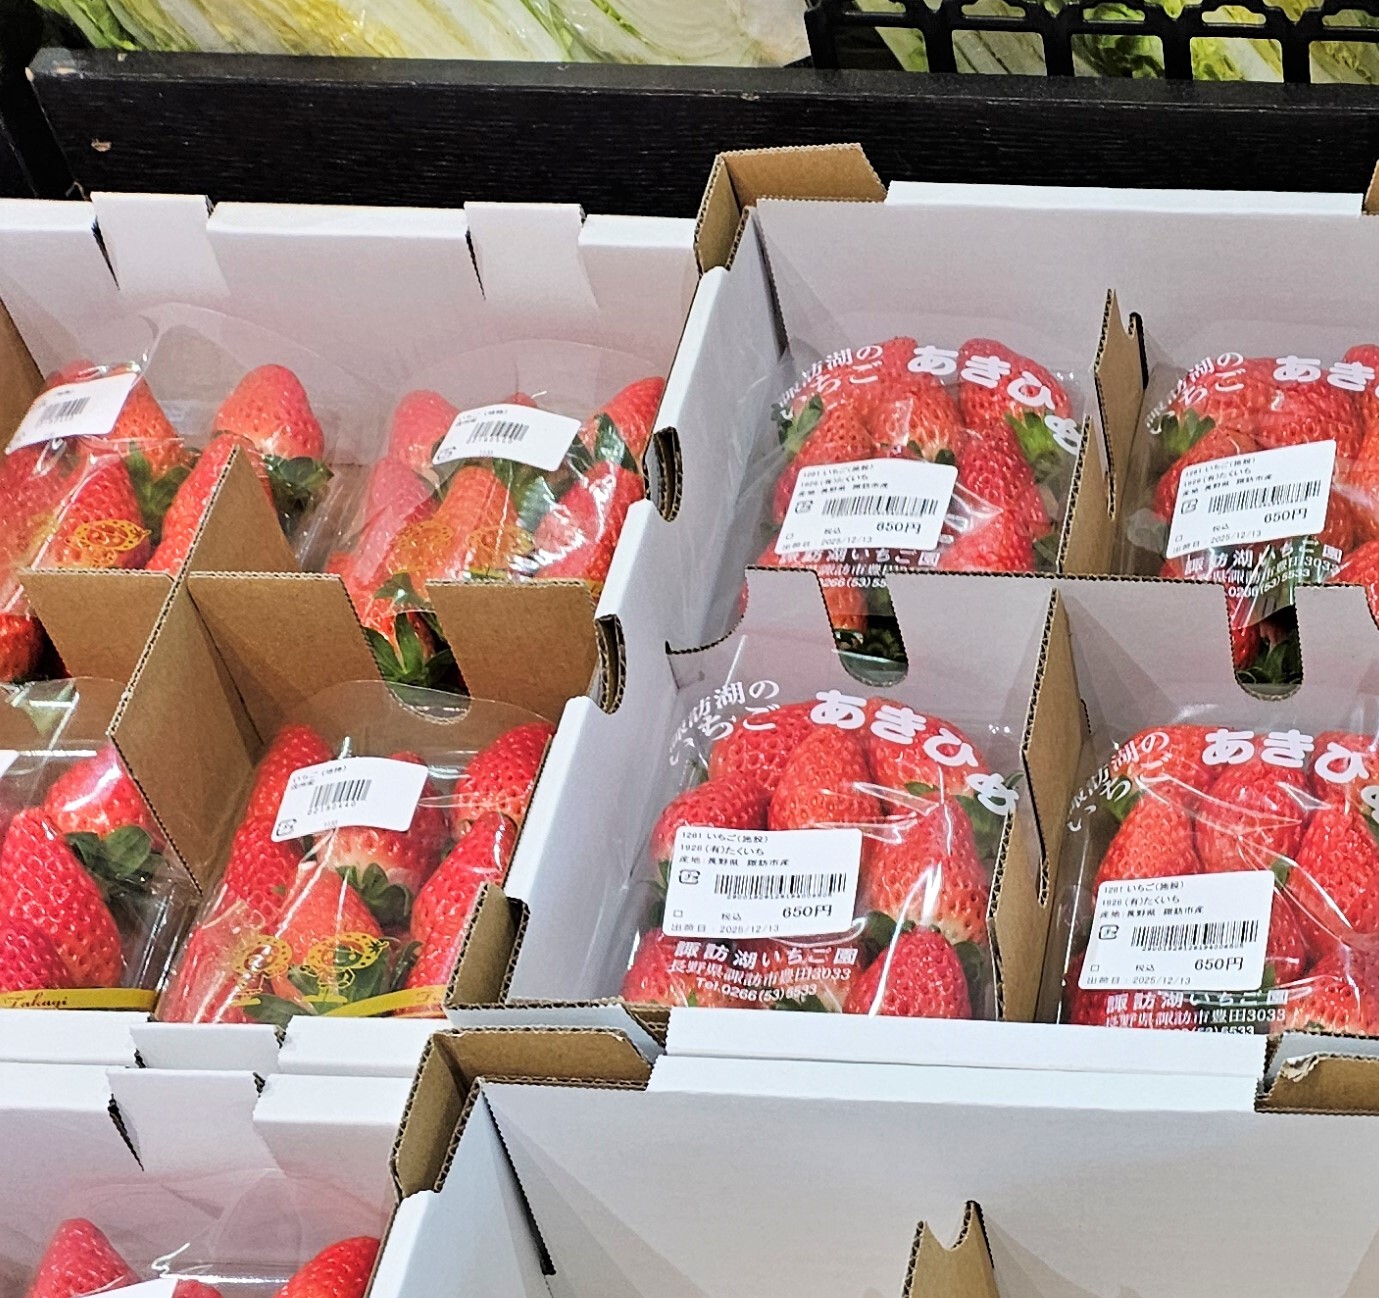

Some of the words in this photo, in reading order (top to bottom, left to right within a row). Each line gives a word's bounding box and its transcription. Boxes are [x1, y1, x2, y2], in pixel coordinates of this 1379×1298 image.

[811, 689, 1019, 815] あきひめ
[674, 941, 858, 969] 諏訪湖いちご園
